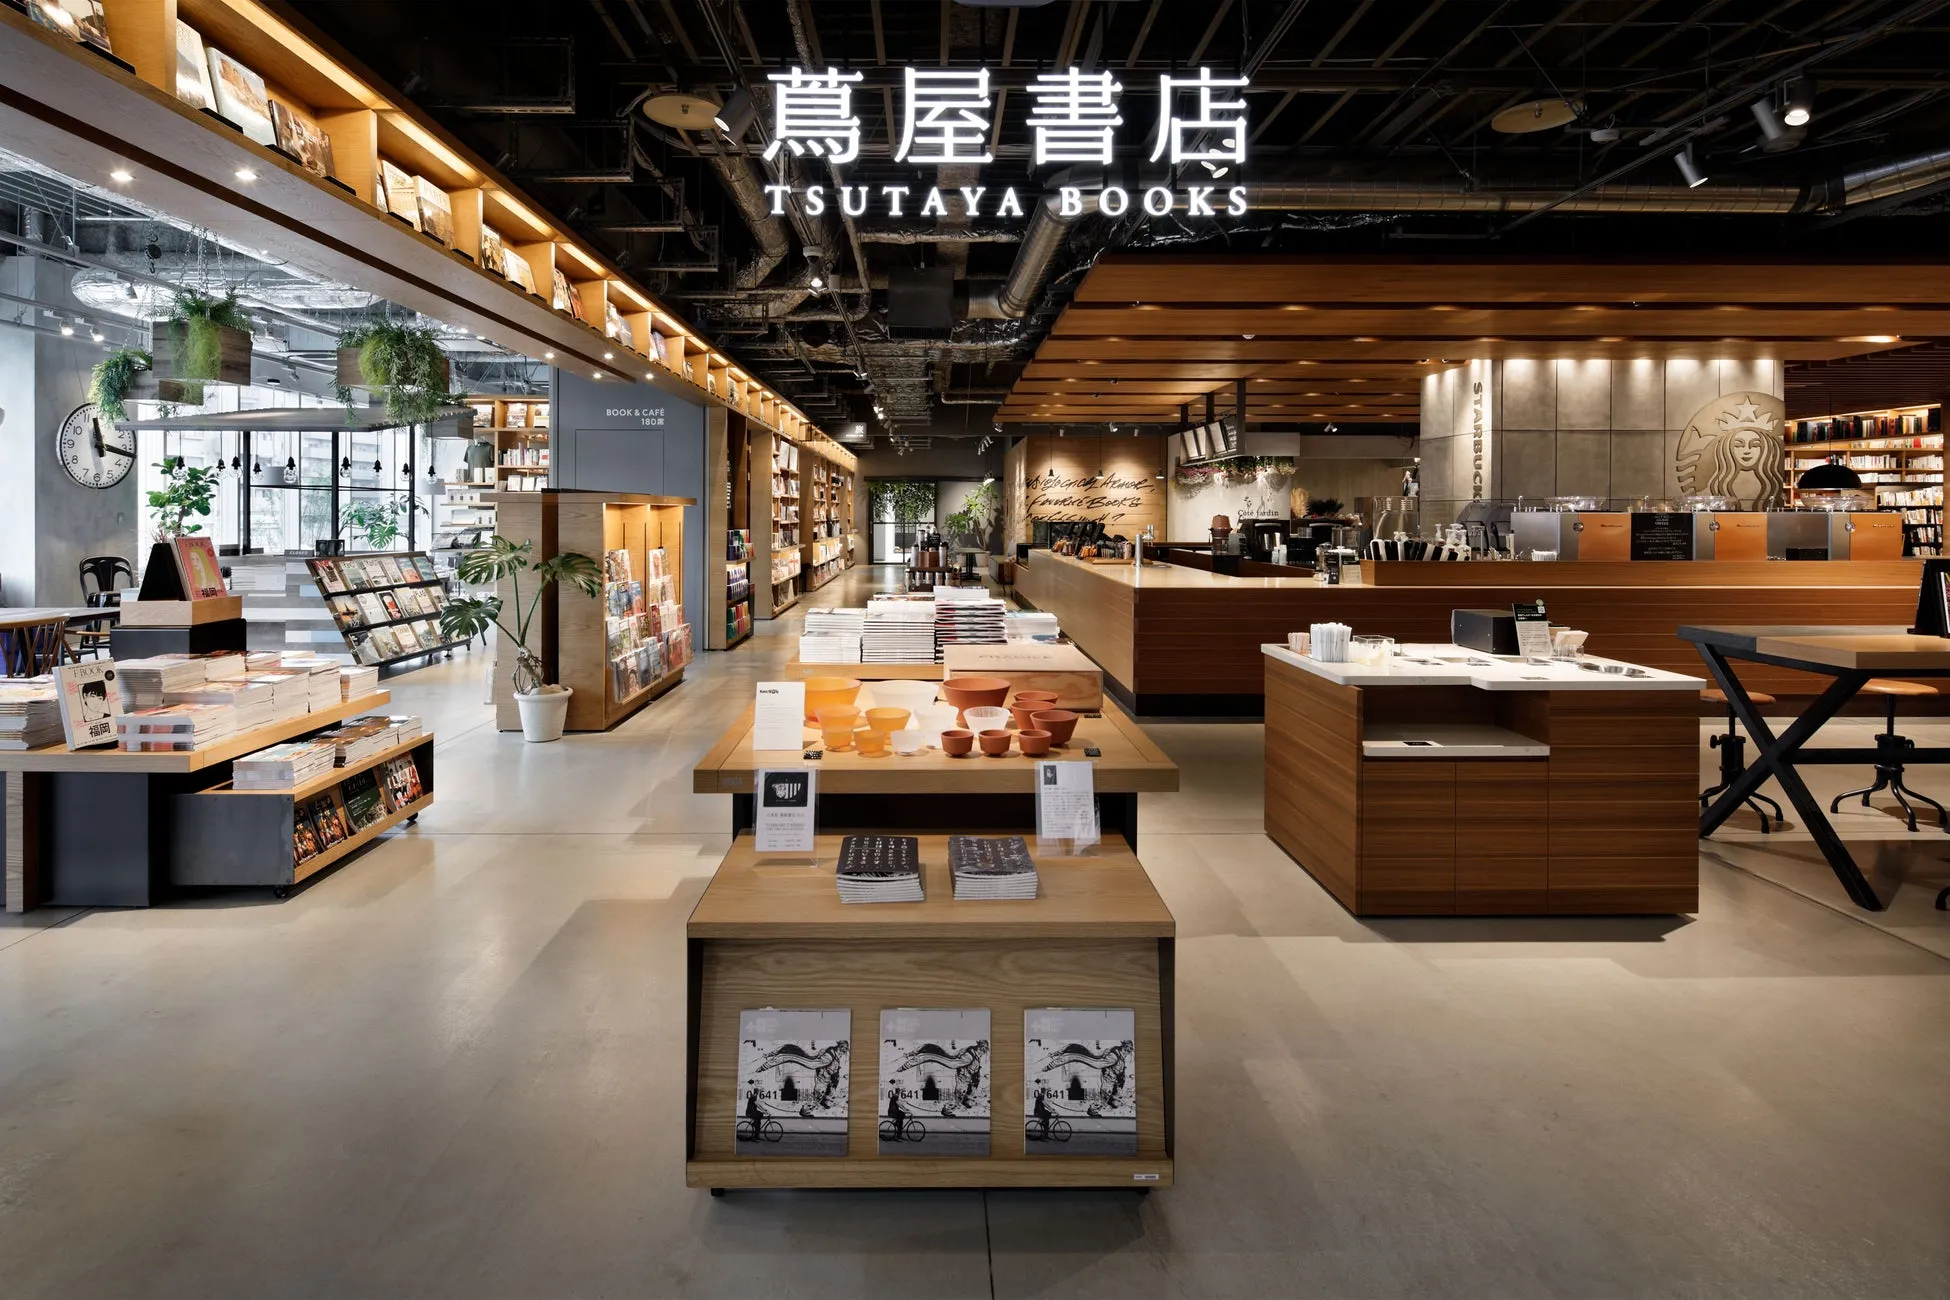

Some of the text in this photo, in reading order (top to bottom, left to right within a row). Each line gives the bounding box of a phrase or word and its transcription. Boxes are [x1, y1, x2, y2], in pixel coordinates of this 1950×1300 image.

[762, 66, 1251, 165] 蔦屋書店
[764, 185, 1249, 217] TSUTAYA BOOKS
[606, 407, 665, 417] BOOK & CAFÉ
[73, 425, 83, 436] 10
[66, 439, 75, 449] 9
[1472, 381, 1484, 503] STARBUCK
[71, 454, 79, 465] 8
[114, 458, 122, 467] 4
[82, 468, 90, 478] 7
[93, 472, 101, 483] 6
[106, 469, 114, 479] 5
[88, 722, 111, 738] 福岡
